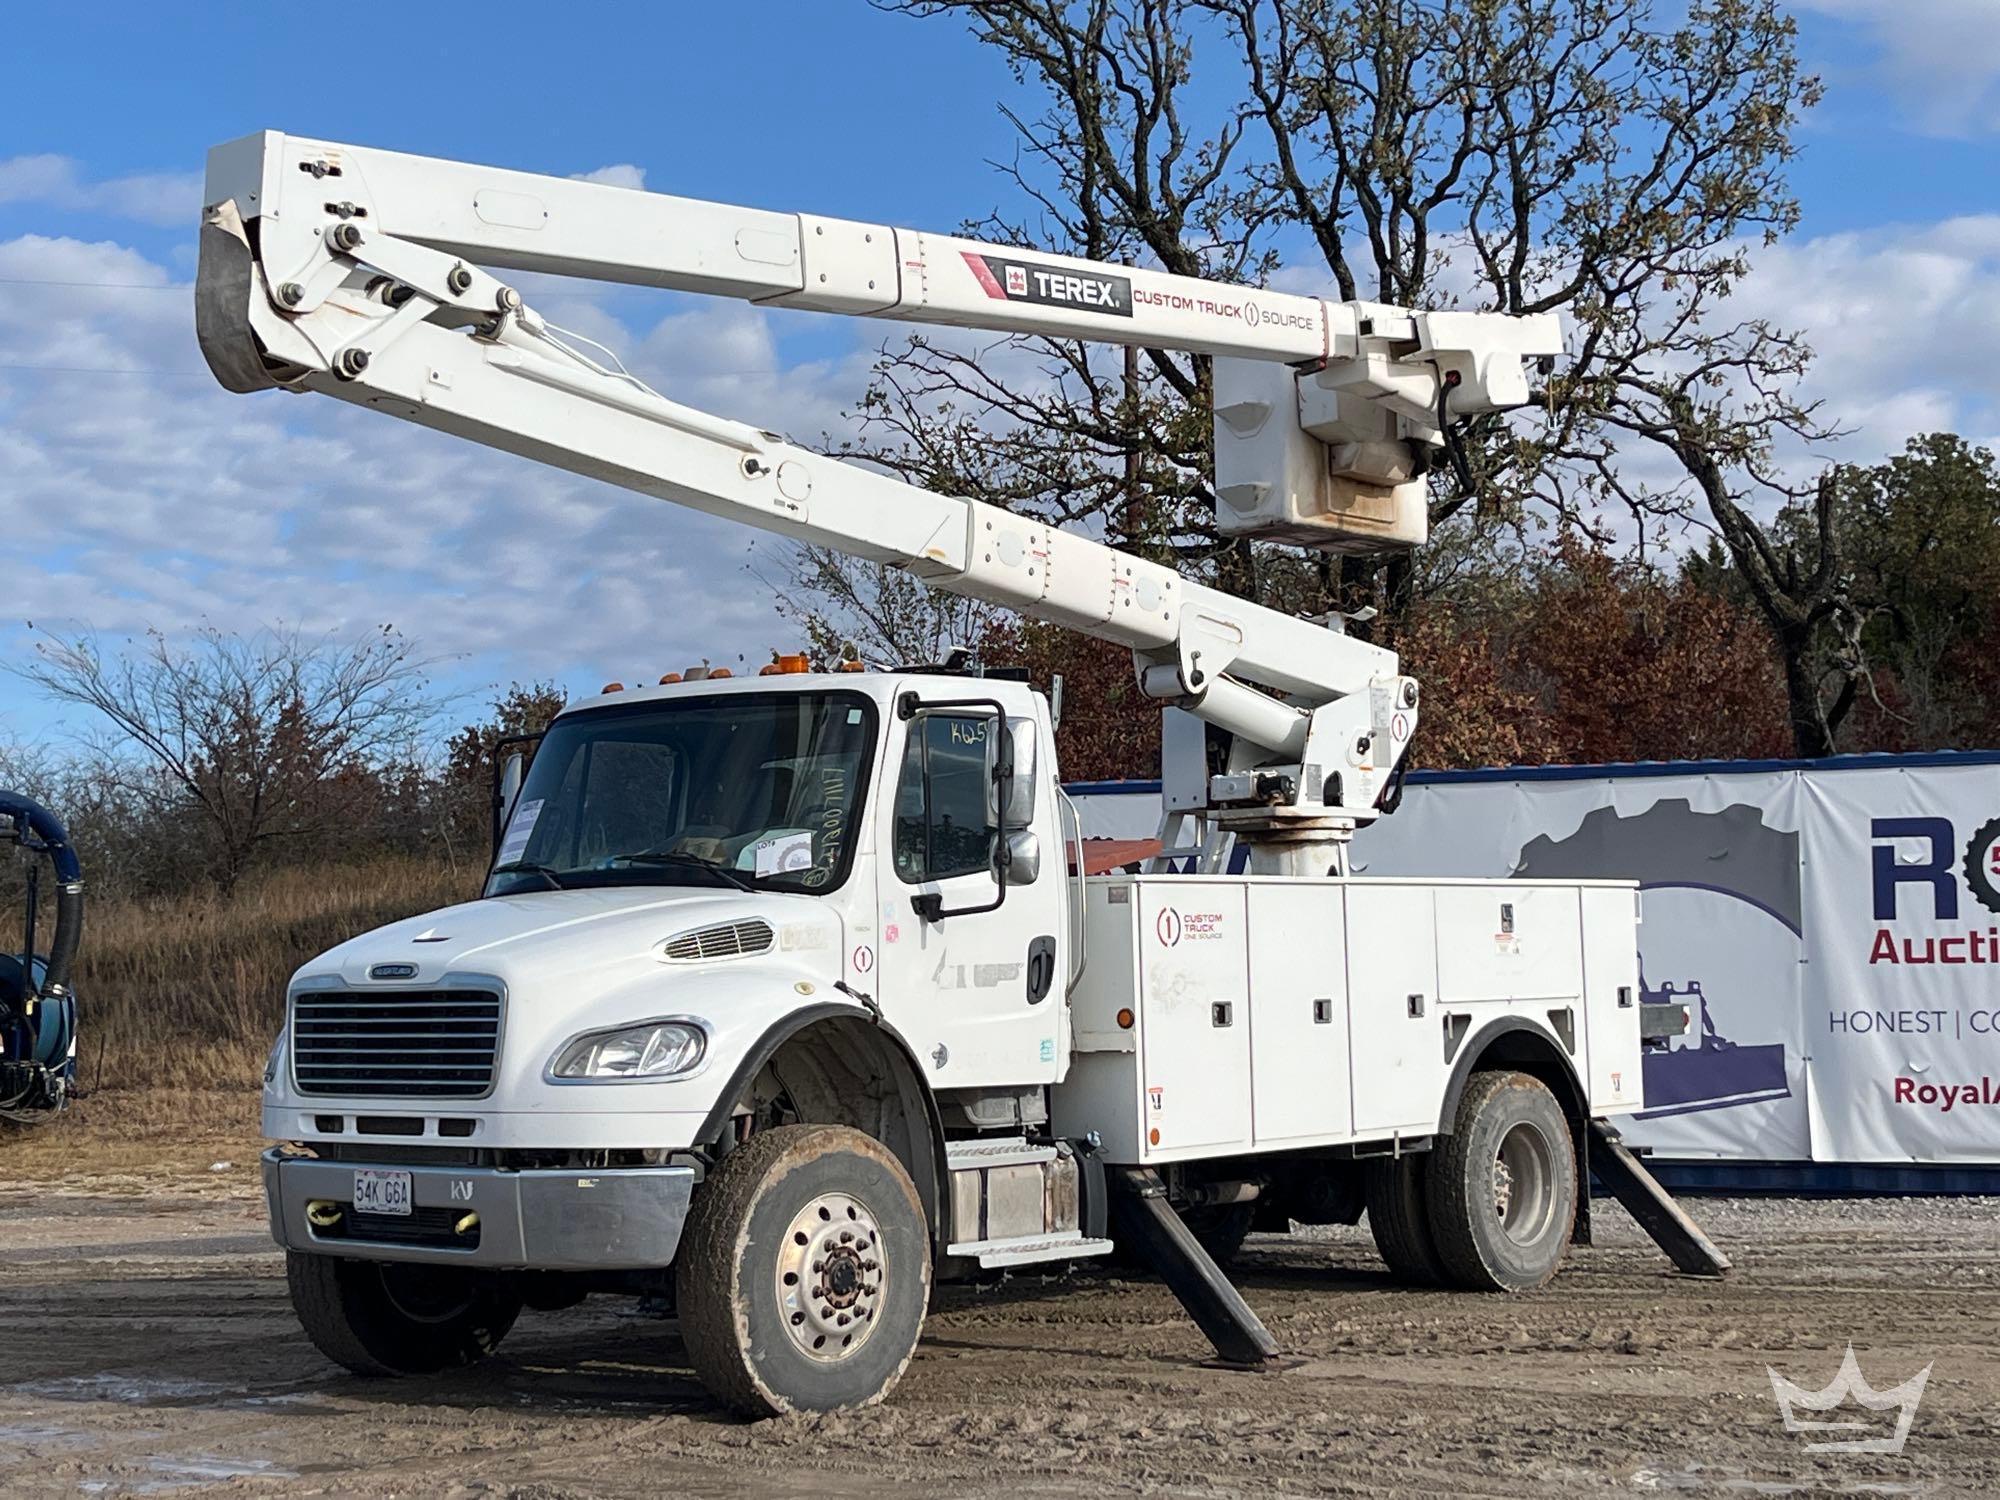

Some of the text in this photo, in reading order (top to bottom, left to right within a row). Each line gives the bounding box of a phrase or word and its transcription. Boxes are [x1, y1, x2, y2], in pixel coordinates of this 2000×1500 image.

[1133, 289, 1194, 312] CUSTOM
[1196, 299, 1242, 320] TRUCK
[1261, 310, 1313, 331] SOURCE
[1183, 914, 1223, 923] CUSTOM
[1184, 924, 1215, 933] TRUCK
[1869, 927, 1999, 964] Aucti
[1829, 1010, 1947, 1033] HONEST
[356, 1180, 379, 1203] 54K
